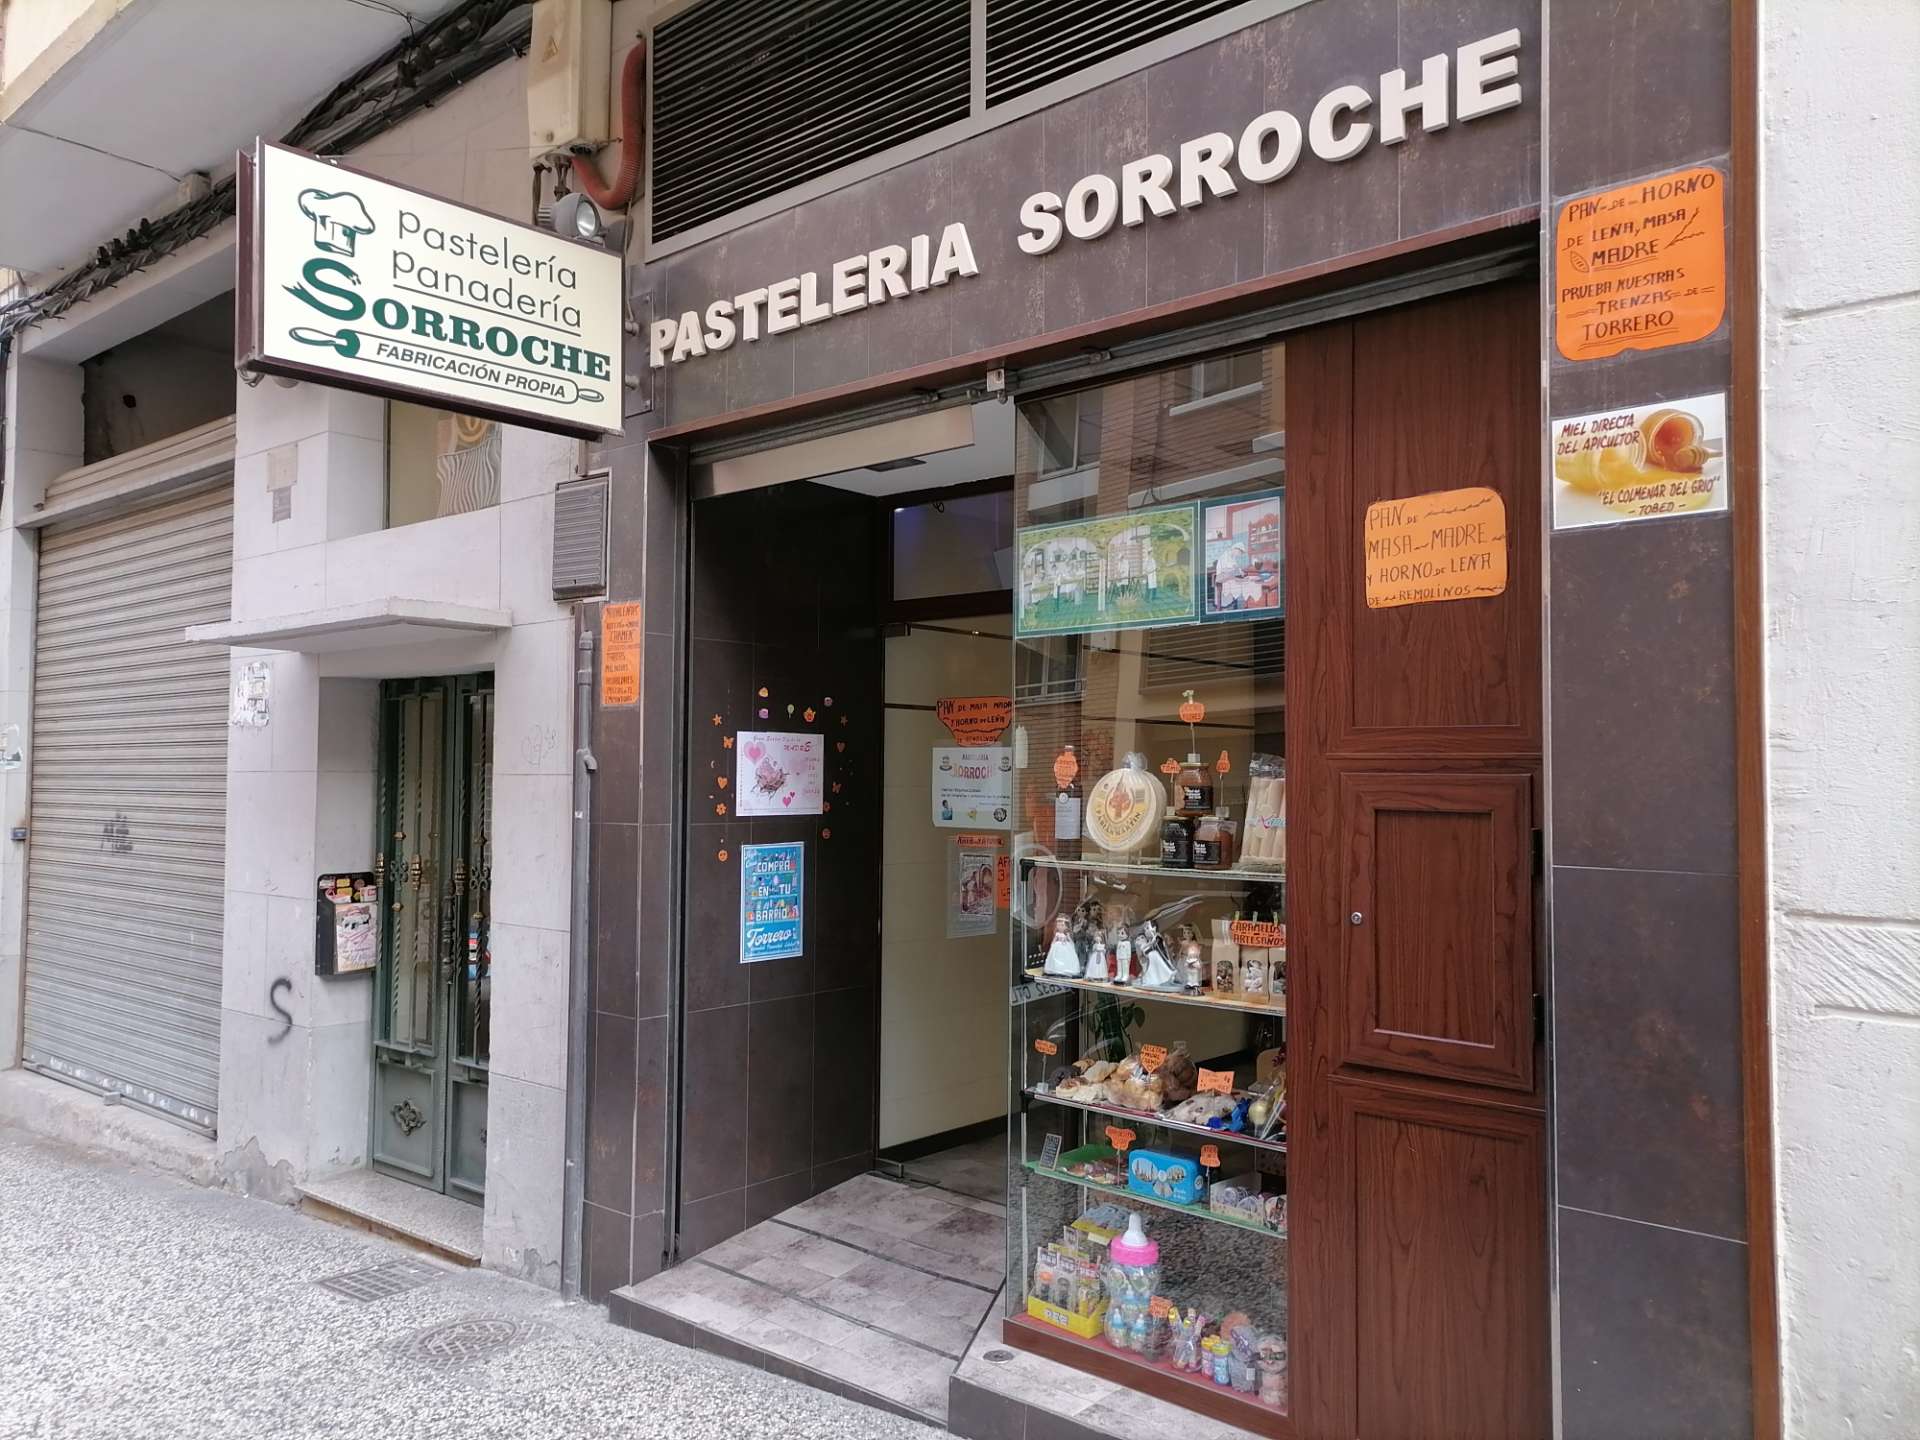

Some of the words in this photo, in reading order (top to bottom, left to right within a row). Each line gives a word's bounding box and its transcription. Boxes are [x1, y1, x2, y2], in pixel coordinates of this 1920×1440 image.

[650, 222, 979, 368] PASTELERIA
[1017, 28, 1522, 256] SORROCHE
[1569, 198, 1601, 222] PAN
[1641, 173, 1715, 204] HORNO
[1565, 235, 1583, 249] DE
[1643, 208, 1686, 229] MASA
[399, 210, 577, 289] Pastelería
[1591, 239, 1660, 267] MADRE
[393, 249, 581, 328] Panadería
[1562, 280, 1612, 303] PRUEBA
[1616, 267, 1685, 292] NUESTRAS
[1597, 290, 1672, 315] TRENZAS
[282, 257, 611, 382] SORROCHE
[1583, 310, 1674, 341] TORRERO
[376, 343, 500, 383] FABRICACIÓN
[505, 374, 566, 399] PROPIA
[1561, 421, 1586, 438] MIEL
[1592, 413, 1634, 433] DIRECTA
[1557, 441, 1578, 455] DEL
[1582, 430, 1640, 451] APICULTOR
[1617, 485, 1666, 503] COLMENAR
[1670, 482, 1687, 496] DEL
[1369, 502, 1406, 530] PAN
[1406, 515, 1417, 526] DE
[1639, 502, 1675, 515] TOBED
[1367, 534, 1412, 560] MASA
[1430, 522, 1487, 550] MADRE
[1380, 561, 1433, 583] HORNO
[1435, 567, 1446, 576] DE
[1451, 552, 1491, 573] LEÑA
[1369, 596, 1379, 606] DE
[757, 860, 790, 873] COMPRA
[758, 885, 769, 897] EN
[779, 884, 791, 895] TU
[756, 908, 787, 921] BARRIO
